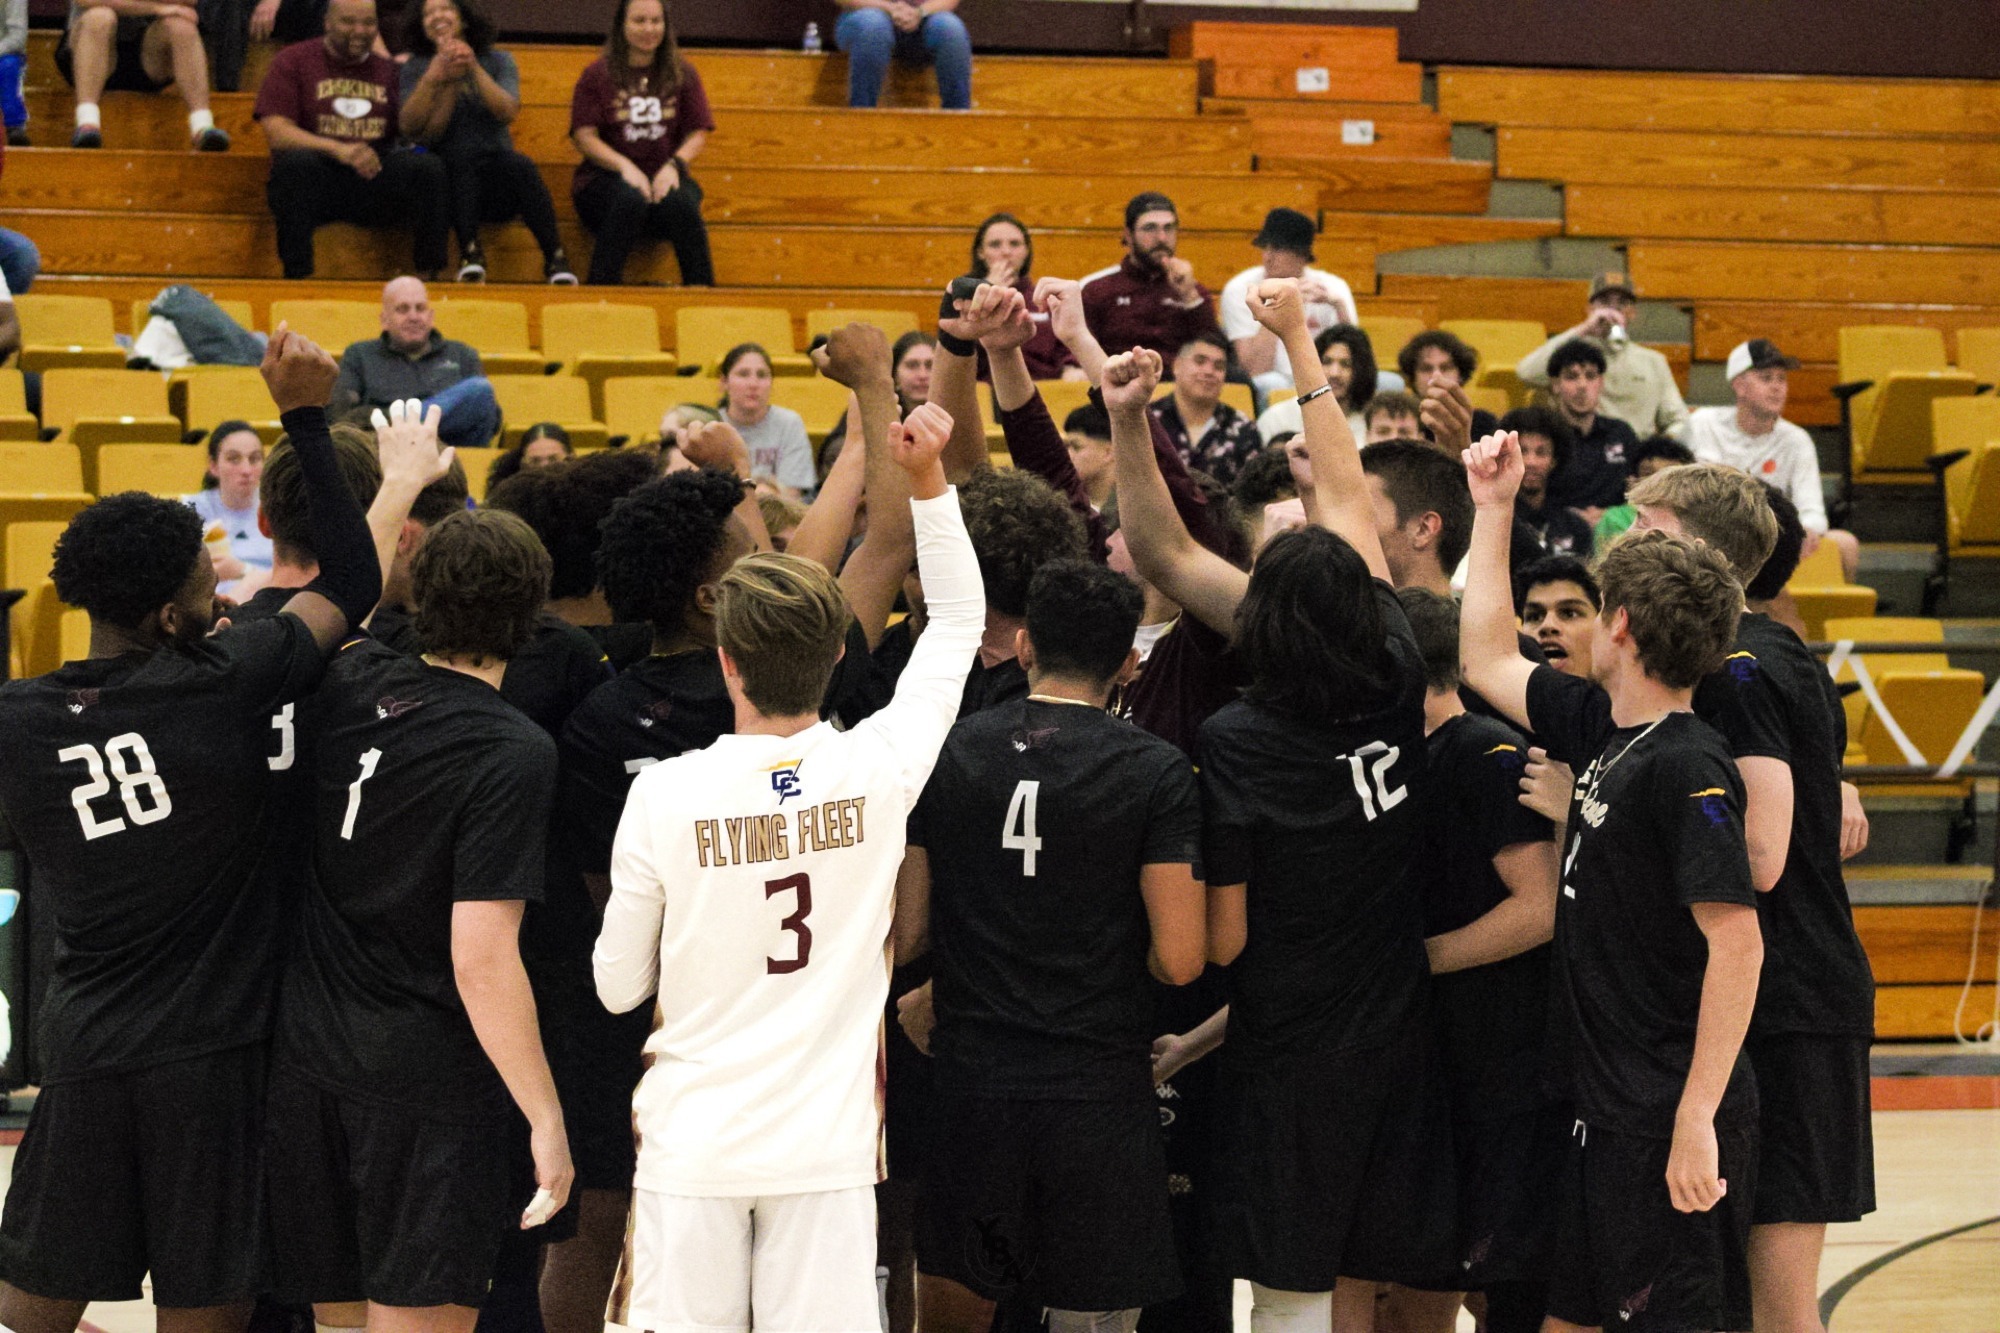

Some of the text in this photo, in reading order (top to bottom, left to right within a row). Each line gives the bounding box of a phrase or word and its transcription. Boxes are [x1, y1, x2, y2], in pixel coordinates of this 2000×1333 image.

[628, 96, 663, 124] 23
[57, 731, 173, 841] 28
[339, 746, 382, 841] 1
[1001, 779, 1043, 877] 4
[1334, 739, 1408, 822] 12
[695, 796, 866, 867] FLYING FLEET
[764, 871, 813, 974] 3
